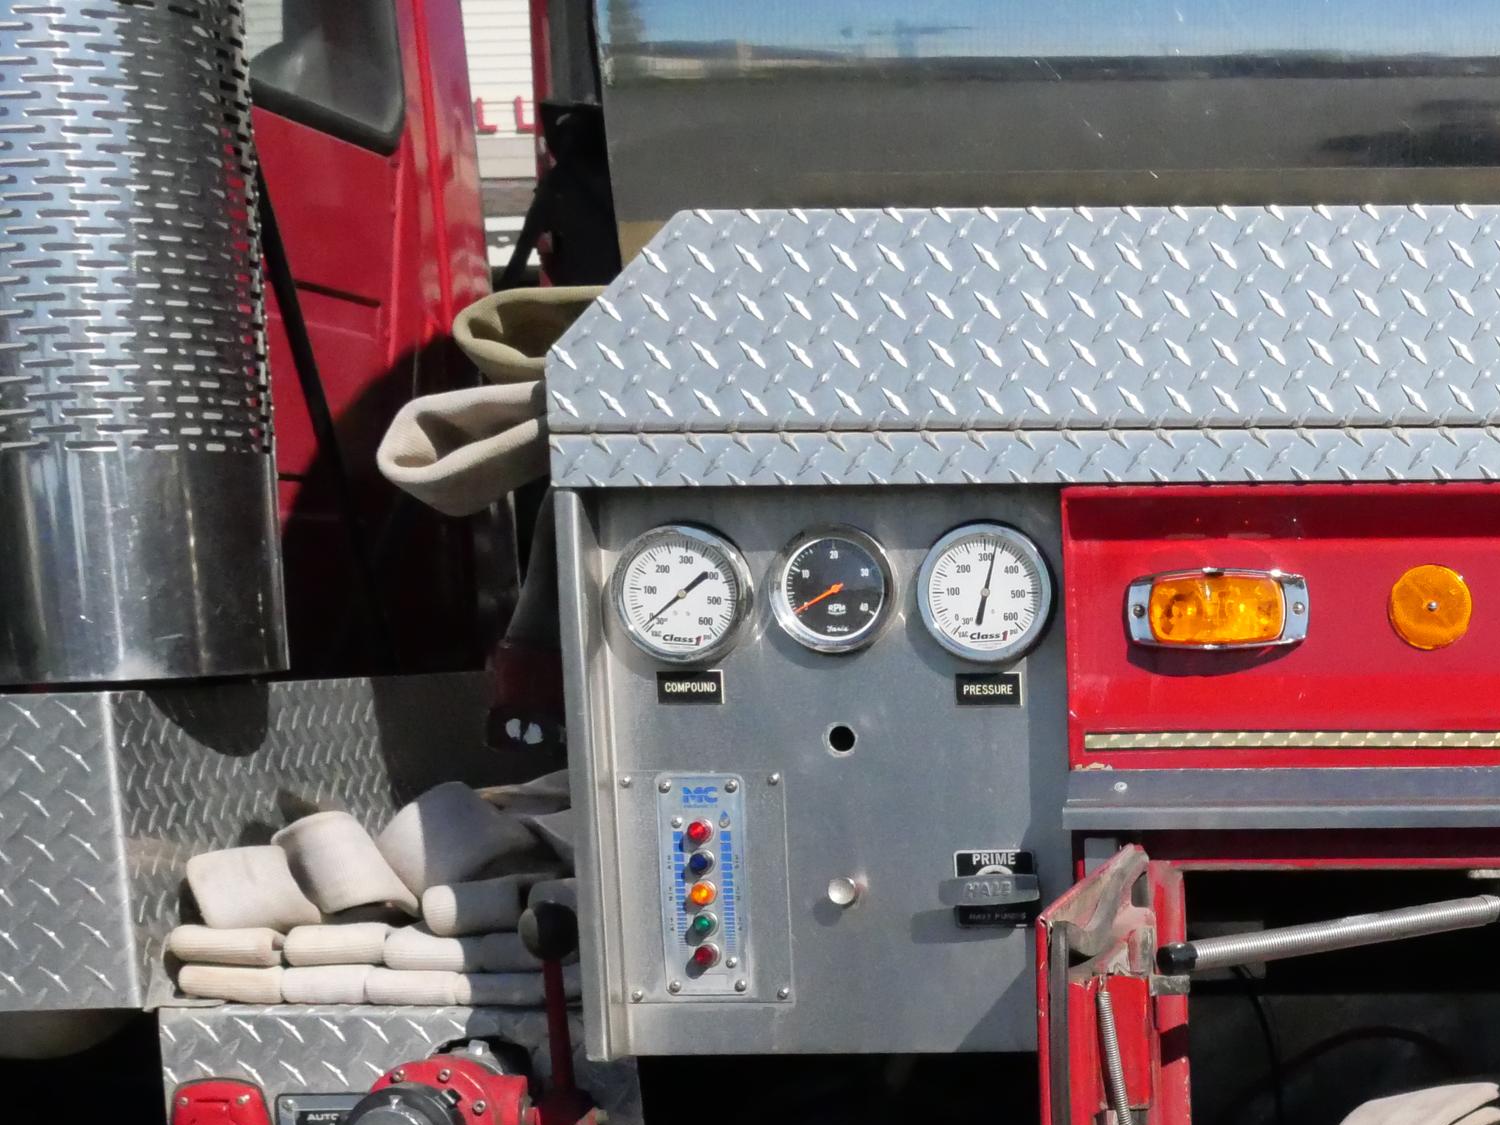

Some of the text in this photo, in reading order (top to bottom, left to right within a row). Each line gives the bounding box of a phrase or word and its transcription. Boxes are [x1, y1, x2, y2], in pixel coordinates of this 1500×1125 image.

[830, 551, 838, 559] 20
[978, 553, 993, 561] 300
[679, 556, 694, 564] 300
[656, 565, 670, 573] 200
[861, 568, 869, 577] 30
[956, 565, 971, 573] 200
[1004, 566, 1019, 574] 400
[802, 570, 810, 578] 10
[644, 586, 657, 594] 100
[946, 587, 960, 596] 100
[1011, 590, 1026, 599] 500
[707, 596, 722, 605] 500
[860, 603, 869, 611] 40
[1003, 613, 1018, 621] 600
[699, 617, 713, 626] 600
[664, 681, 717, 693] COMPOUND
[963, 684, 1014, 695] PRESSURE
[972, 853, 1016, 866] PRIME
